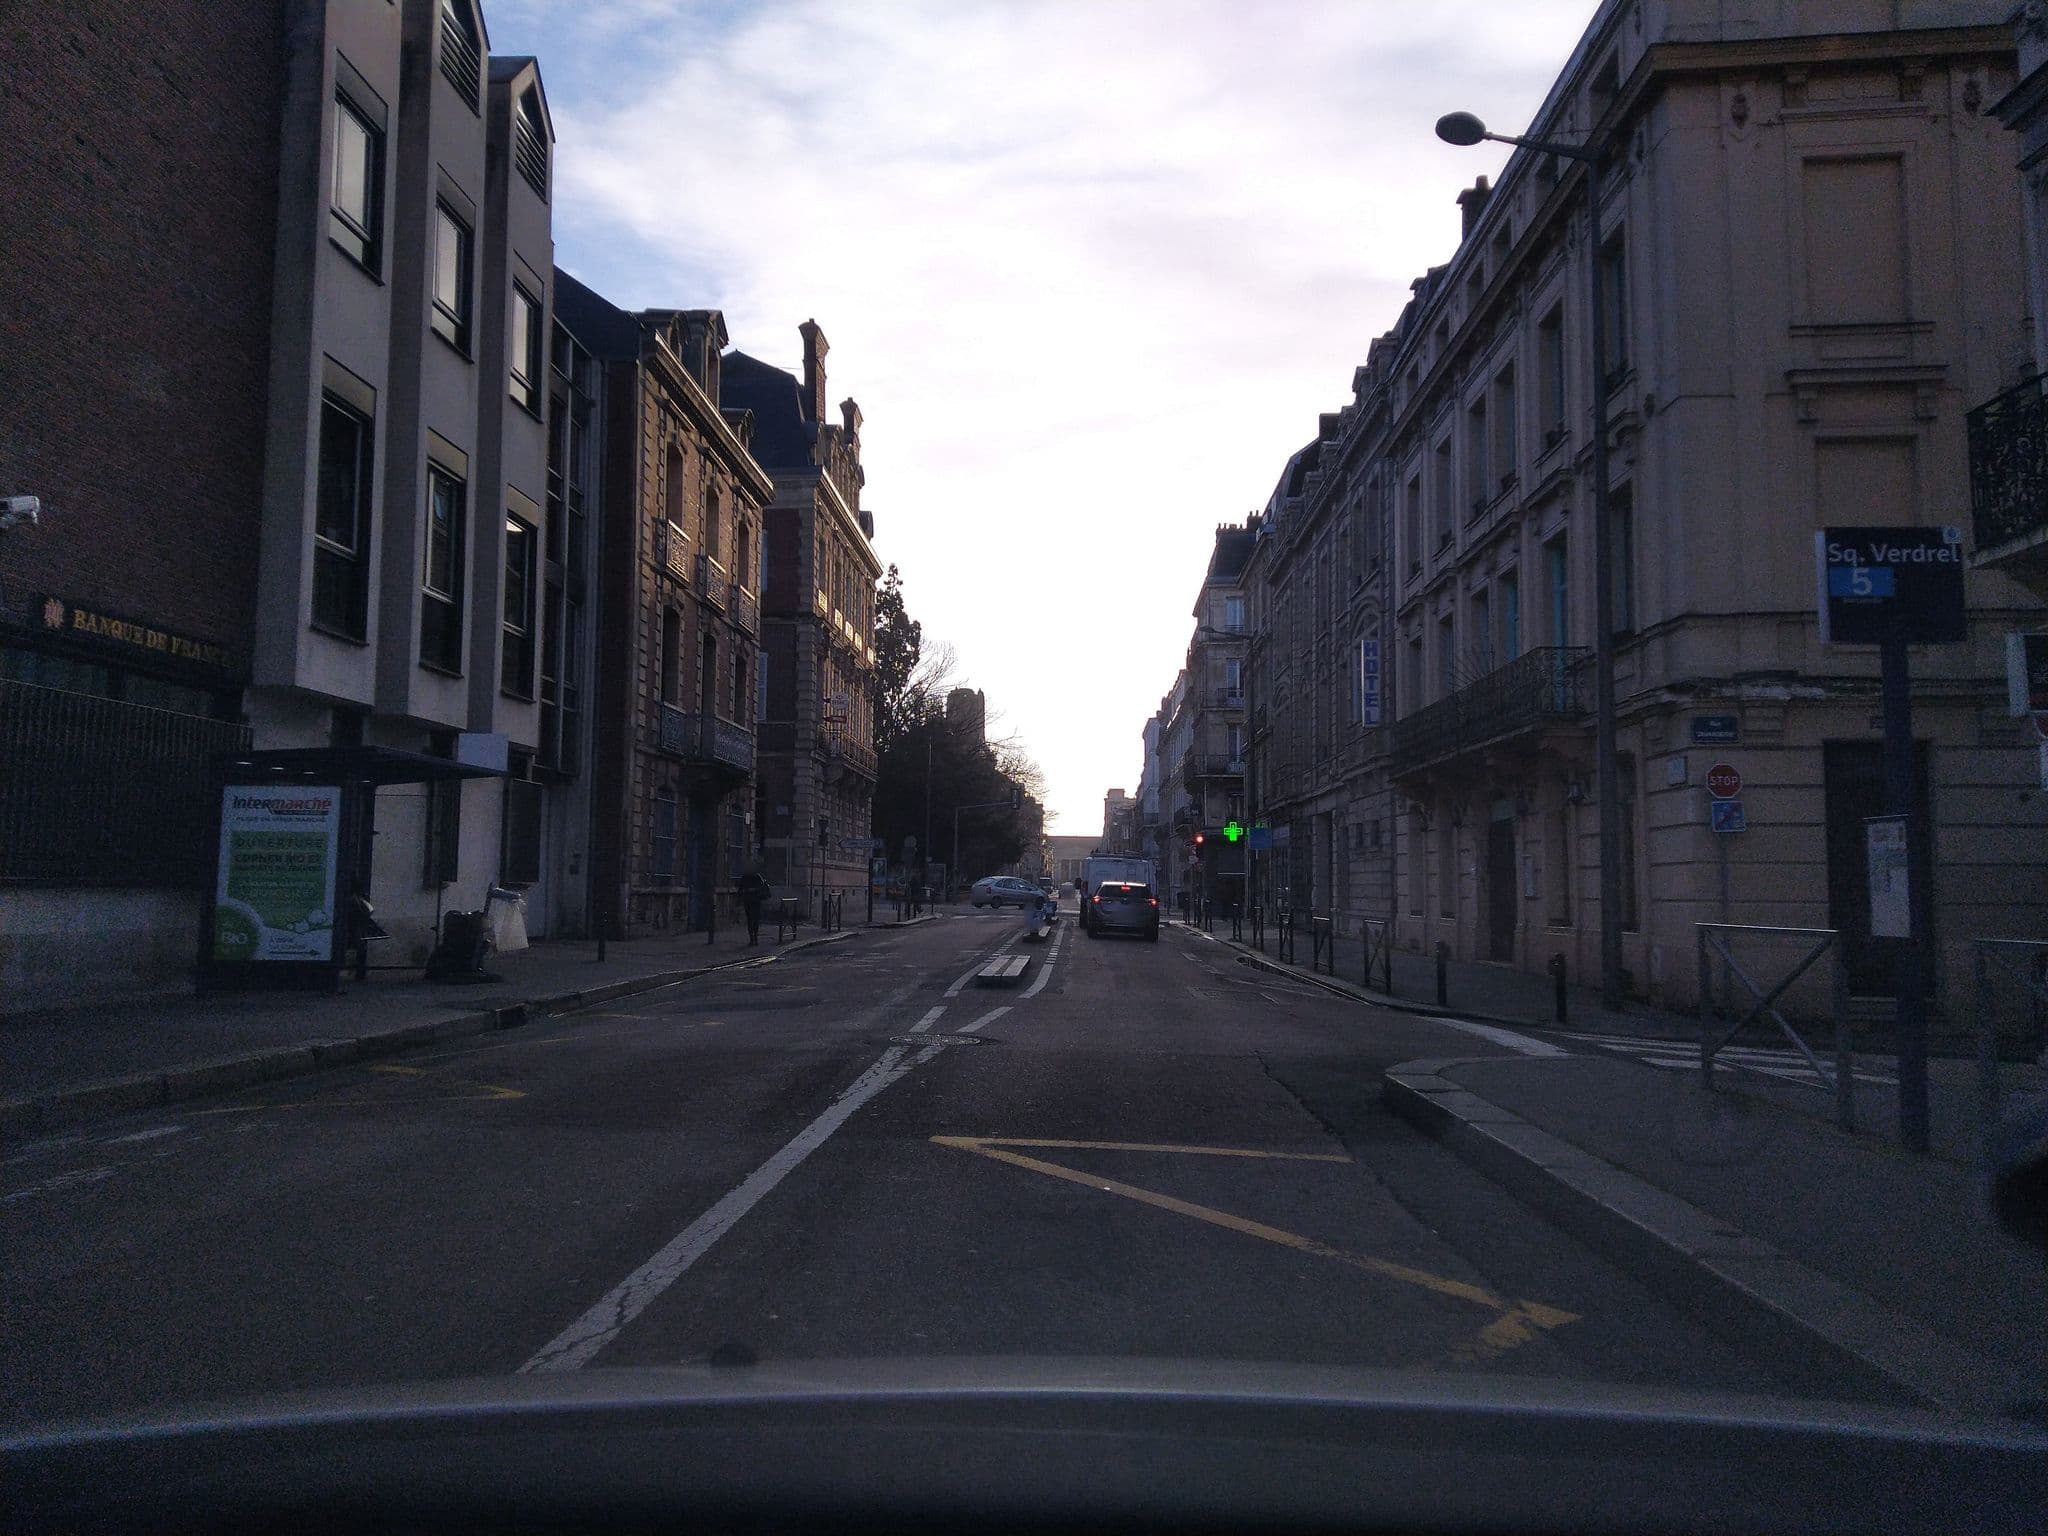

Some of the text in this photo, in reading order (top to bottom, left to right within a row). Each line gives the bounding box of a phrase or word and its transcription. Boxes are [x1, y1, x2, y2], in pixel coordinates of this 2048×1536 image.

[1828, 543, 1961, 567] Sq. Verdrel
[1851, 566, 1873, 595] 5
[72, 608, 144, 645] BANQUE
[1710, 775, 1738, 787] STOP
[223, 932, 248, 945] BIO
